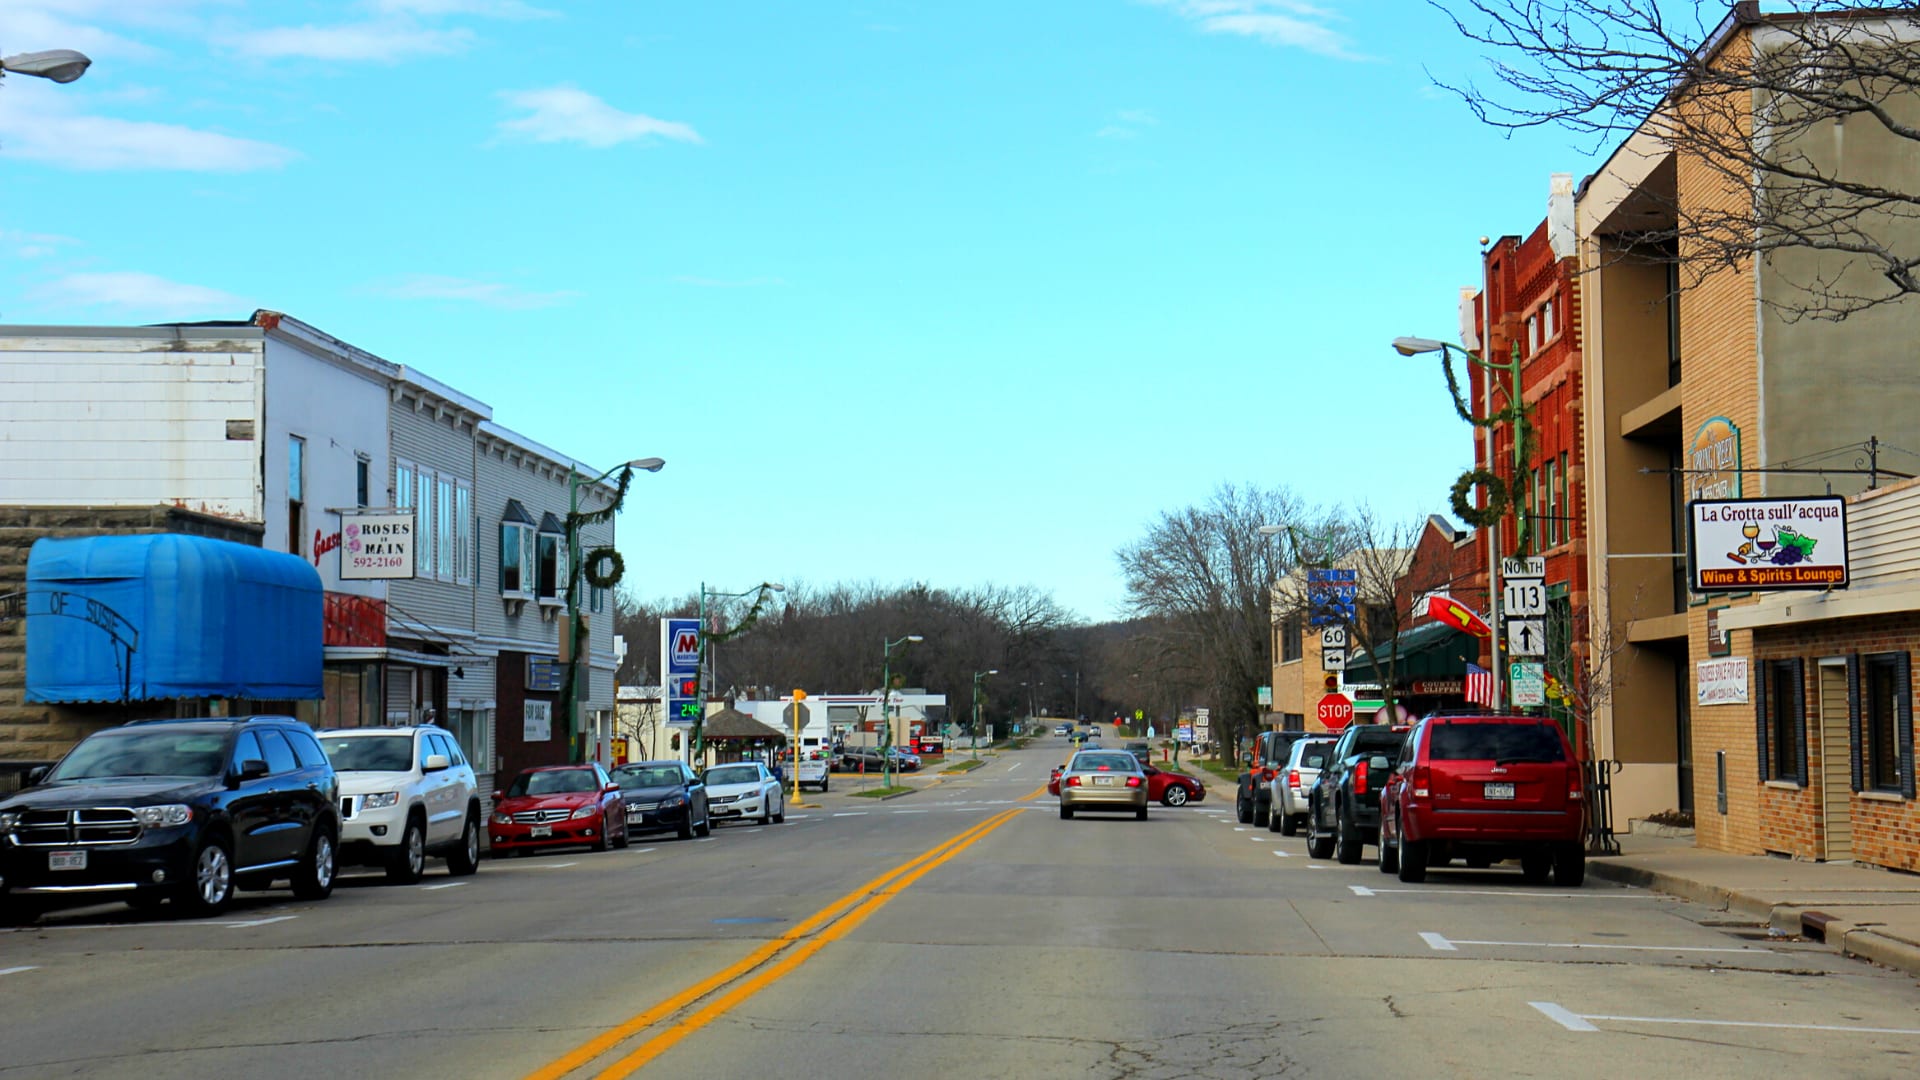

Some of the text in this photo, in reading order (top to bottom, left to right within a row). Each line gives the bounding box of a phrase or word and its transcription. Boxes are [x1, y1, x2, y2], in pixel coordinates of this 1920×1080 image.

[1701, 504, 1839, 522] La Grotta sull'acqua
[362, 523, 410, 535] ROSES
[365, 543, 405, 554] MAIN
[353, 557, 402, 568] 592-2160
[1702, 567, 1843, 585] Wine & Spirits Lounge
[50, 591, 70, 615] OF
[1509, 586, 1540, 609] 113
[1324, 630, 1344, 643] 60
[1513, 665, 1521, 679] 2
[1319, 704, 1351, 719] STOP
